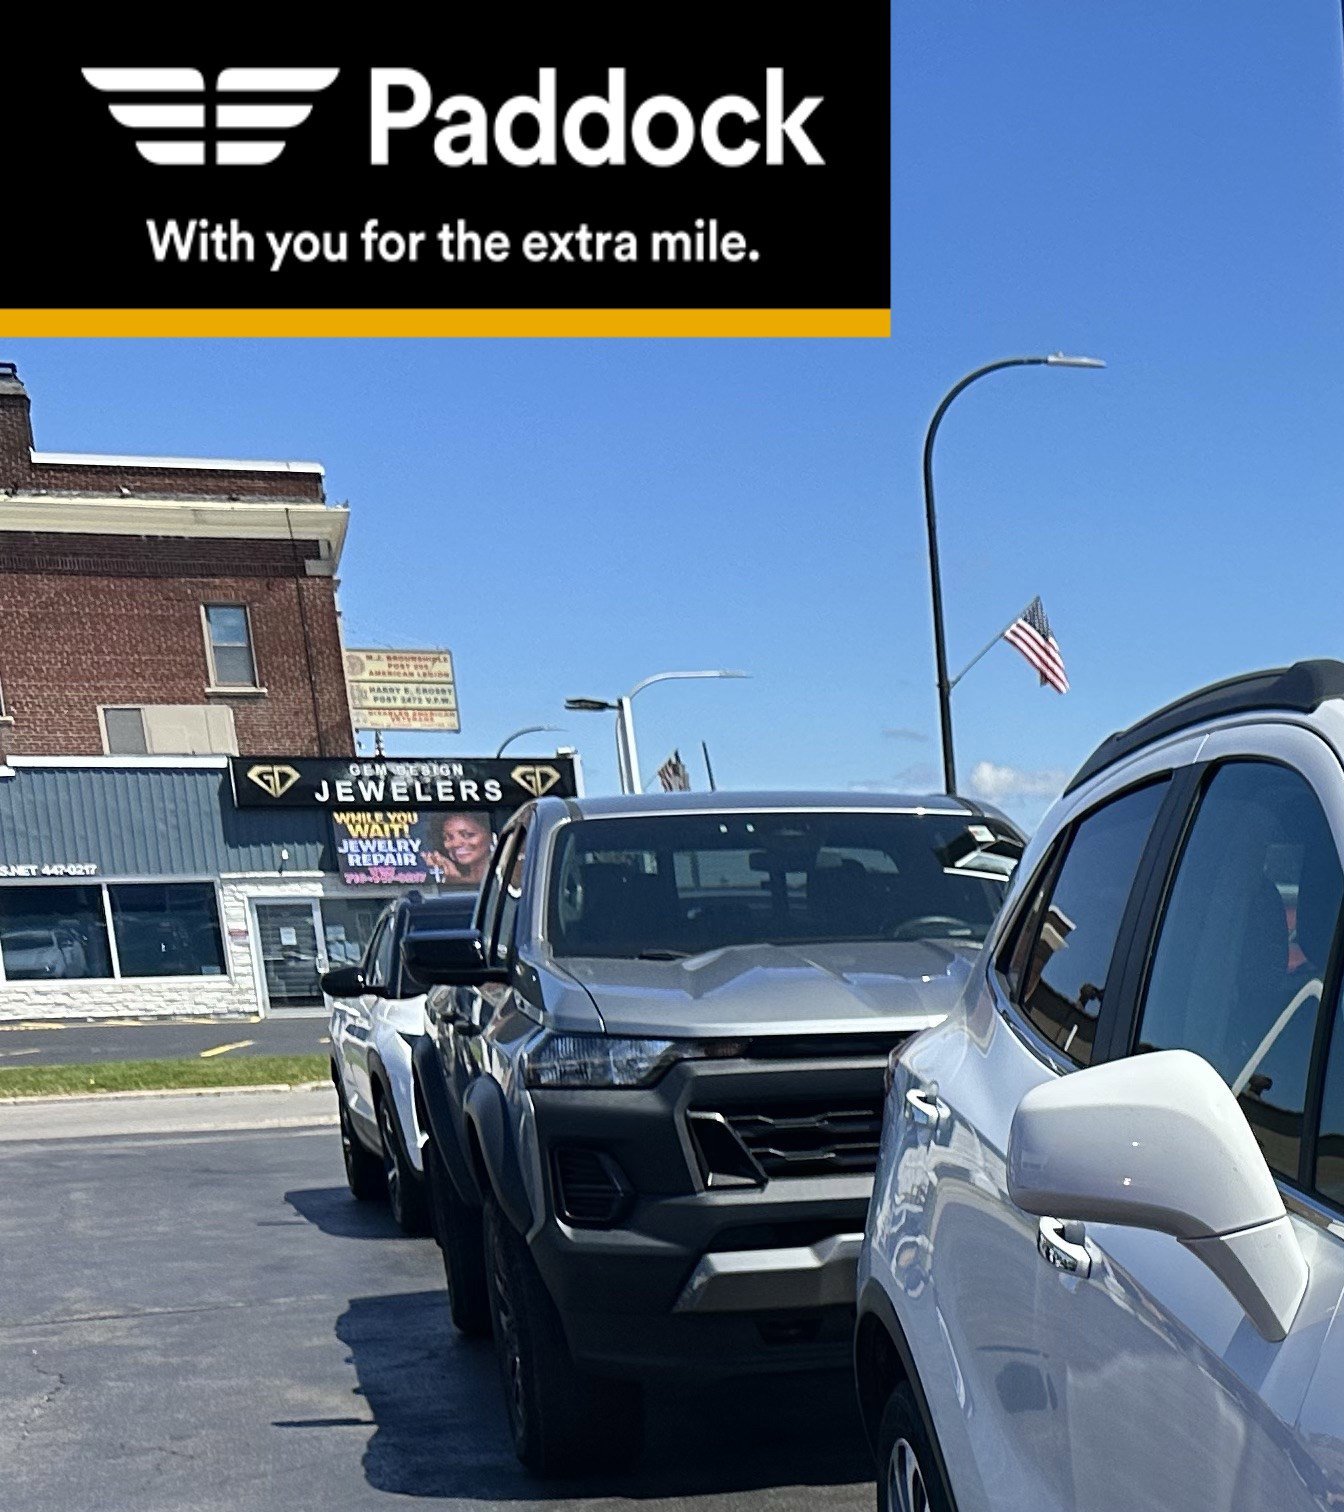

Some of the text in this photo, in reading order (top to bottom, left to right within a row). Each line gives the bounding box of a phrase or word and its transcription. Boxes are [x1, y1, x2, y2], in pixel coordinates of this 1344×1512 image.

[349, 764, 464, 777] GEM DESIGN
[314, 779, 503, 803] JEWELERS
[333, 811, 419, 824] WHILE YOU
[347, 824, 410, 838] WAIT!
[337, 839, 422, 853] JEWELRY
[347, 853, 417, 866] REPAIR
